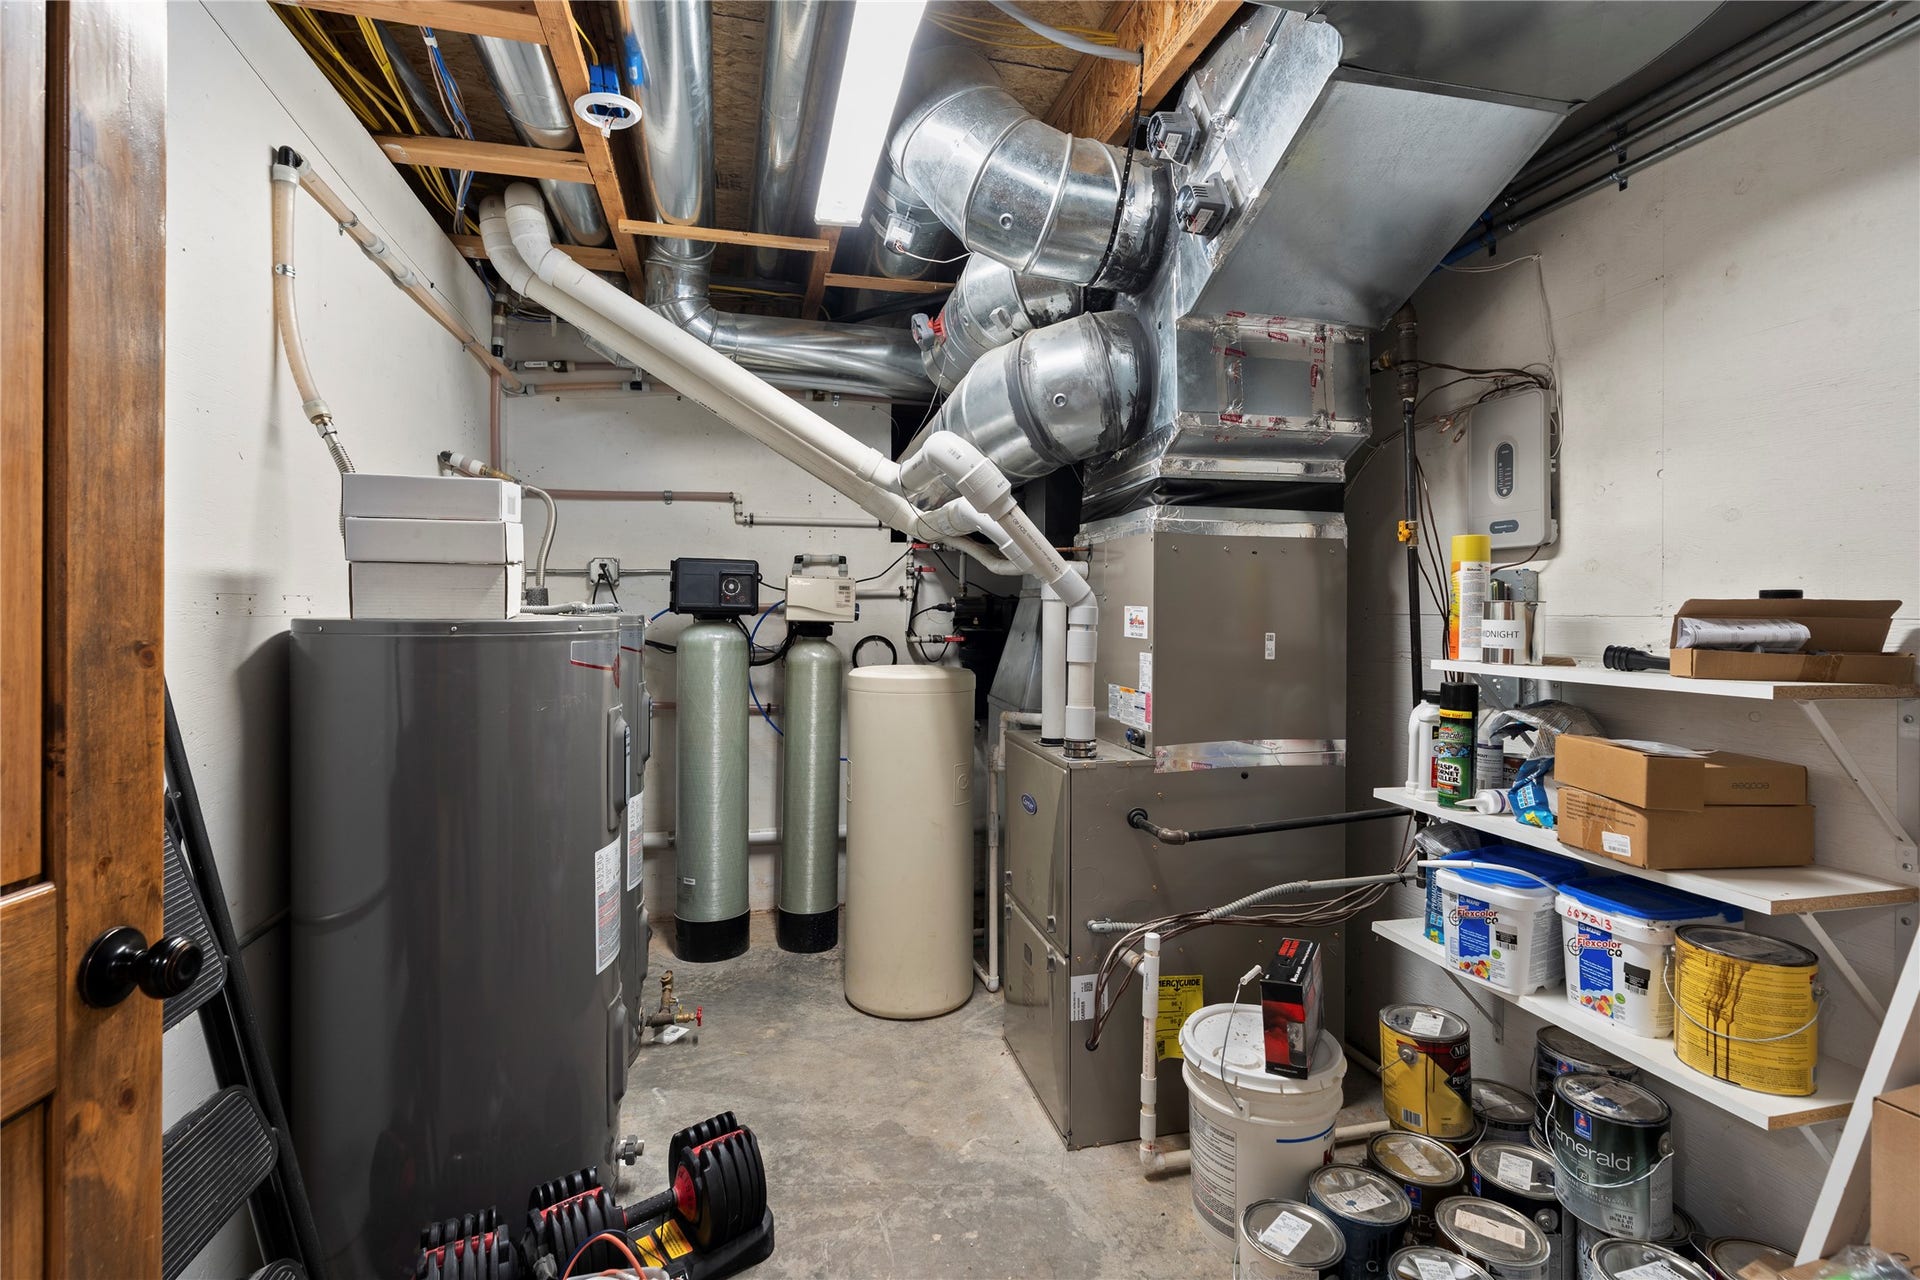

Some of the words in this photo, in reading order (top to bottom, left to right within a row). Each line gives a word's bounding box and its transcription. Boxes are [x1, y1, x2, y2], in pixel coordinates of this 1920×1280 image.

[1438, 762, 1453, 772] ASP
[1438, 769, 1460, 778] RNET
[1438, 775, 1460, 784] ILLER
[1457, 909, 1498, 917] Flexcolor
[1577, 938, 1622, 949] Flexcolor
[1608, 948, 1623, 957] CQ
[1158, 978, 1200, 989] NERGYGUIDE
[1555, 1126, 1632, 1172] Emerald
